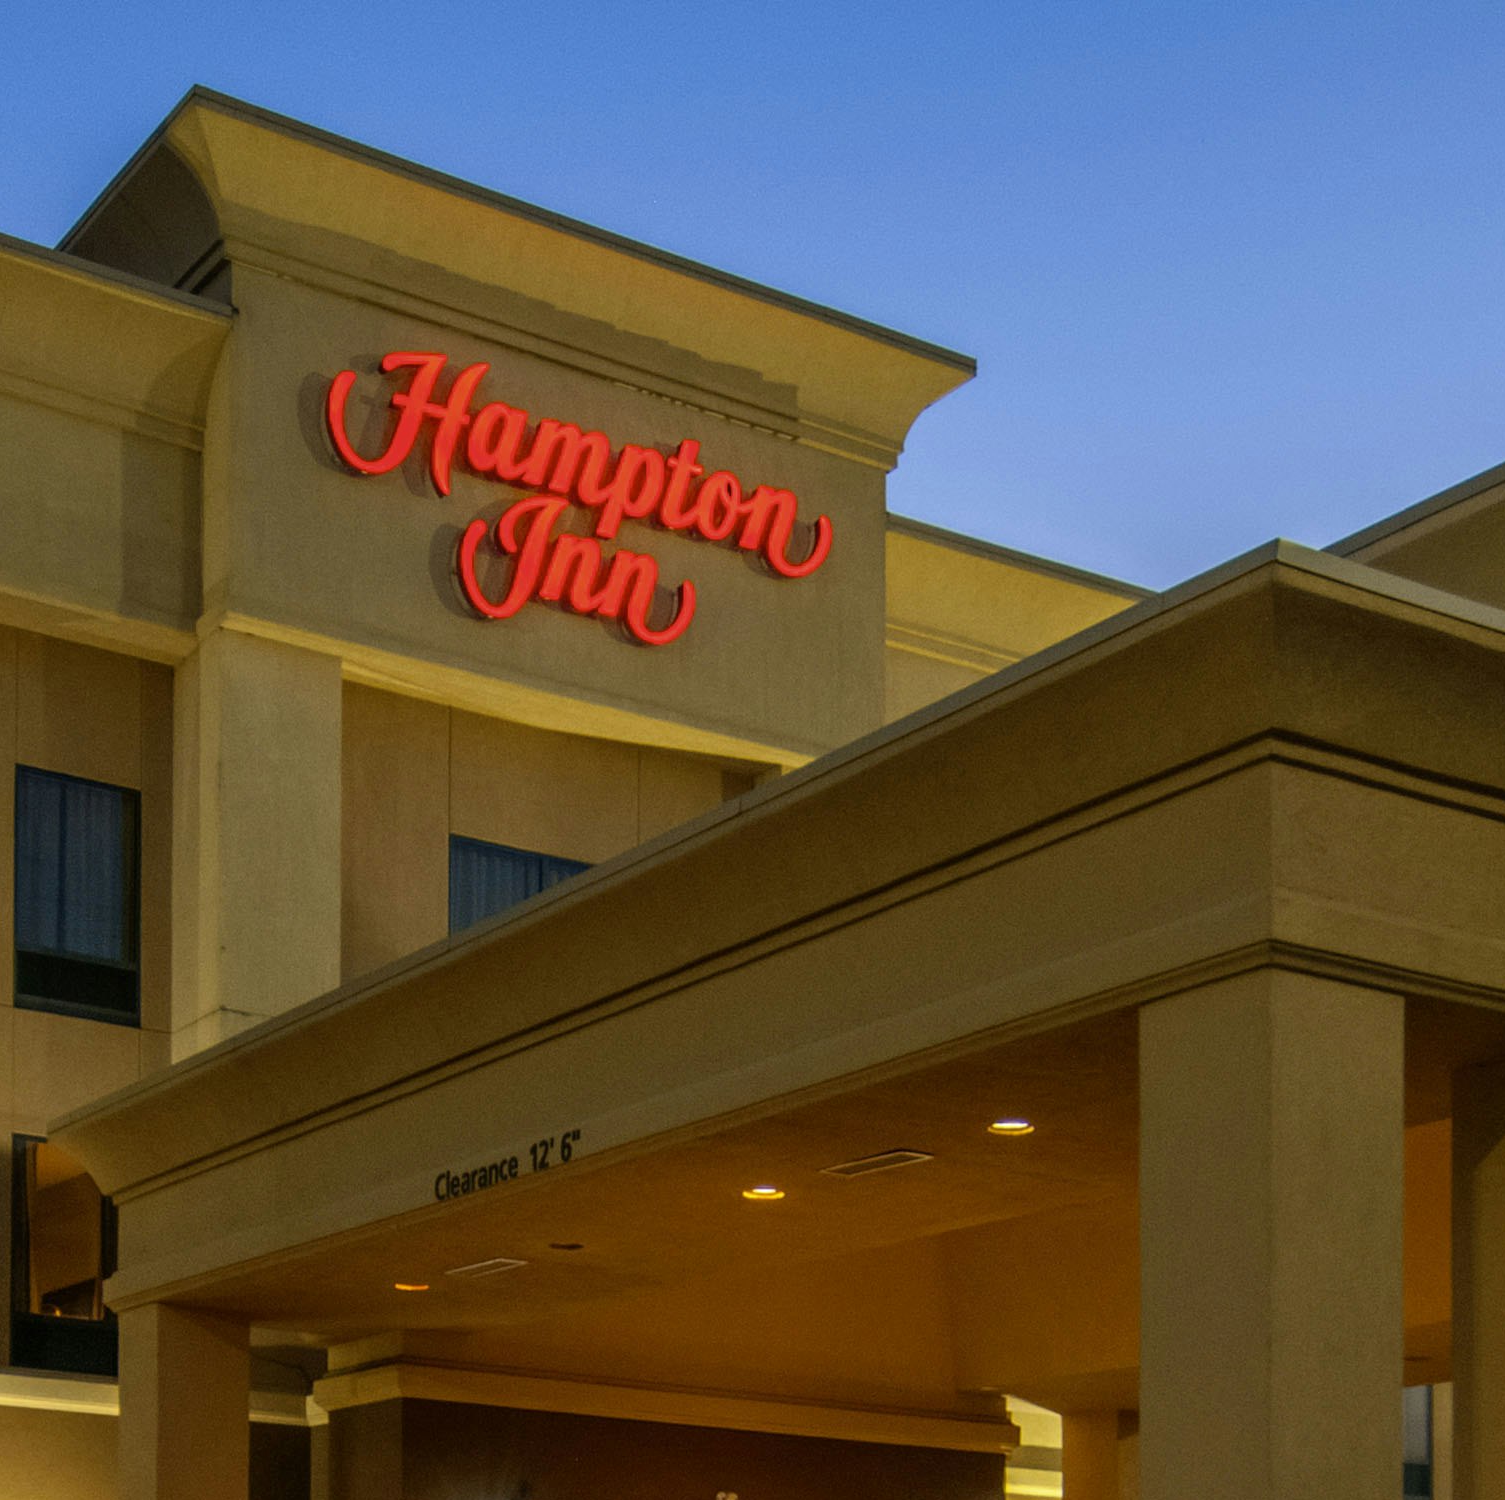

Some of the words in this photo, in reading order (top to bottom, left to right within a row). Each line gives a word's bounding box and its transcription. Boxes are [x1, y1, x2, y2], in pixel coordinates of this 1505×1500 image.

[326, 351, 833, 578] Hampton
[459, 495, 695, 645] Inn
[435, 1155, 518, 1201] Clearance
[529, 1137, 554, 1172] 12'
[560, 1129, 581, 1162] 6"
